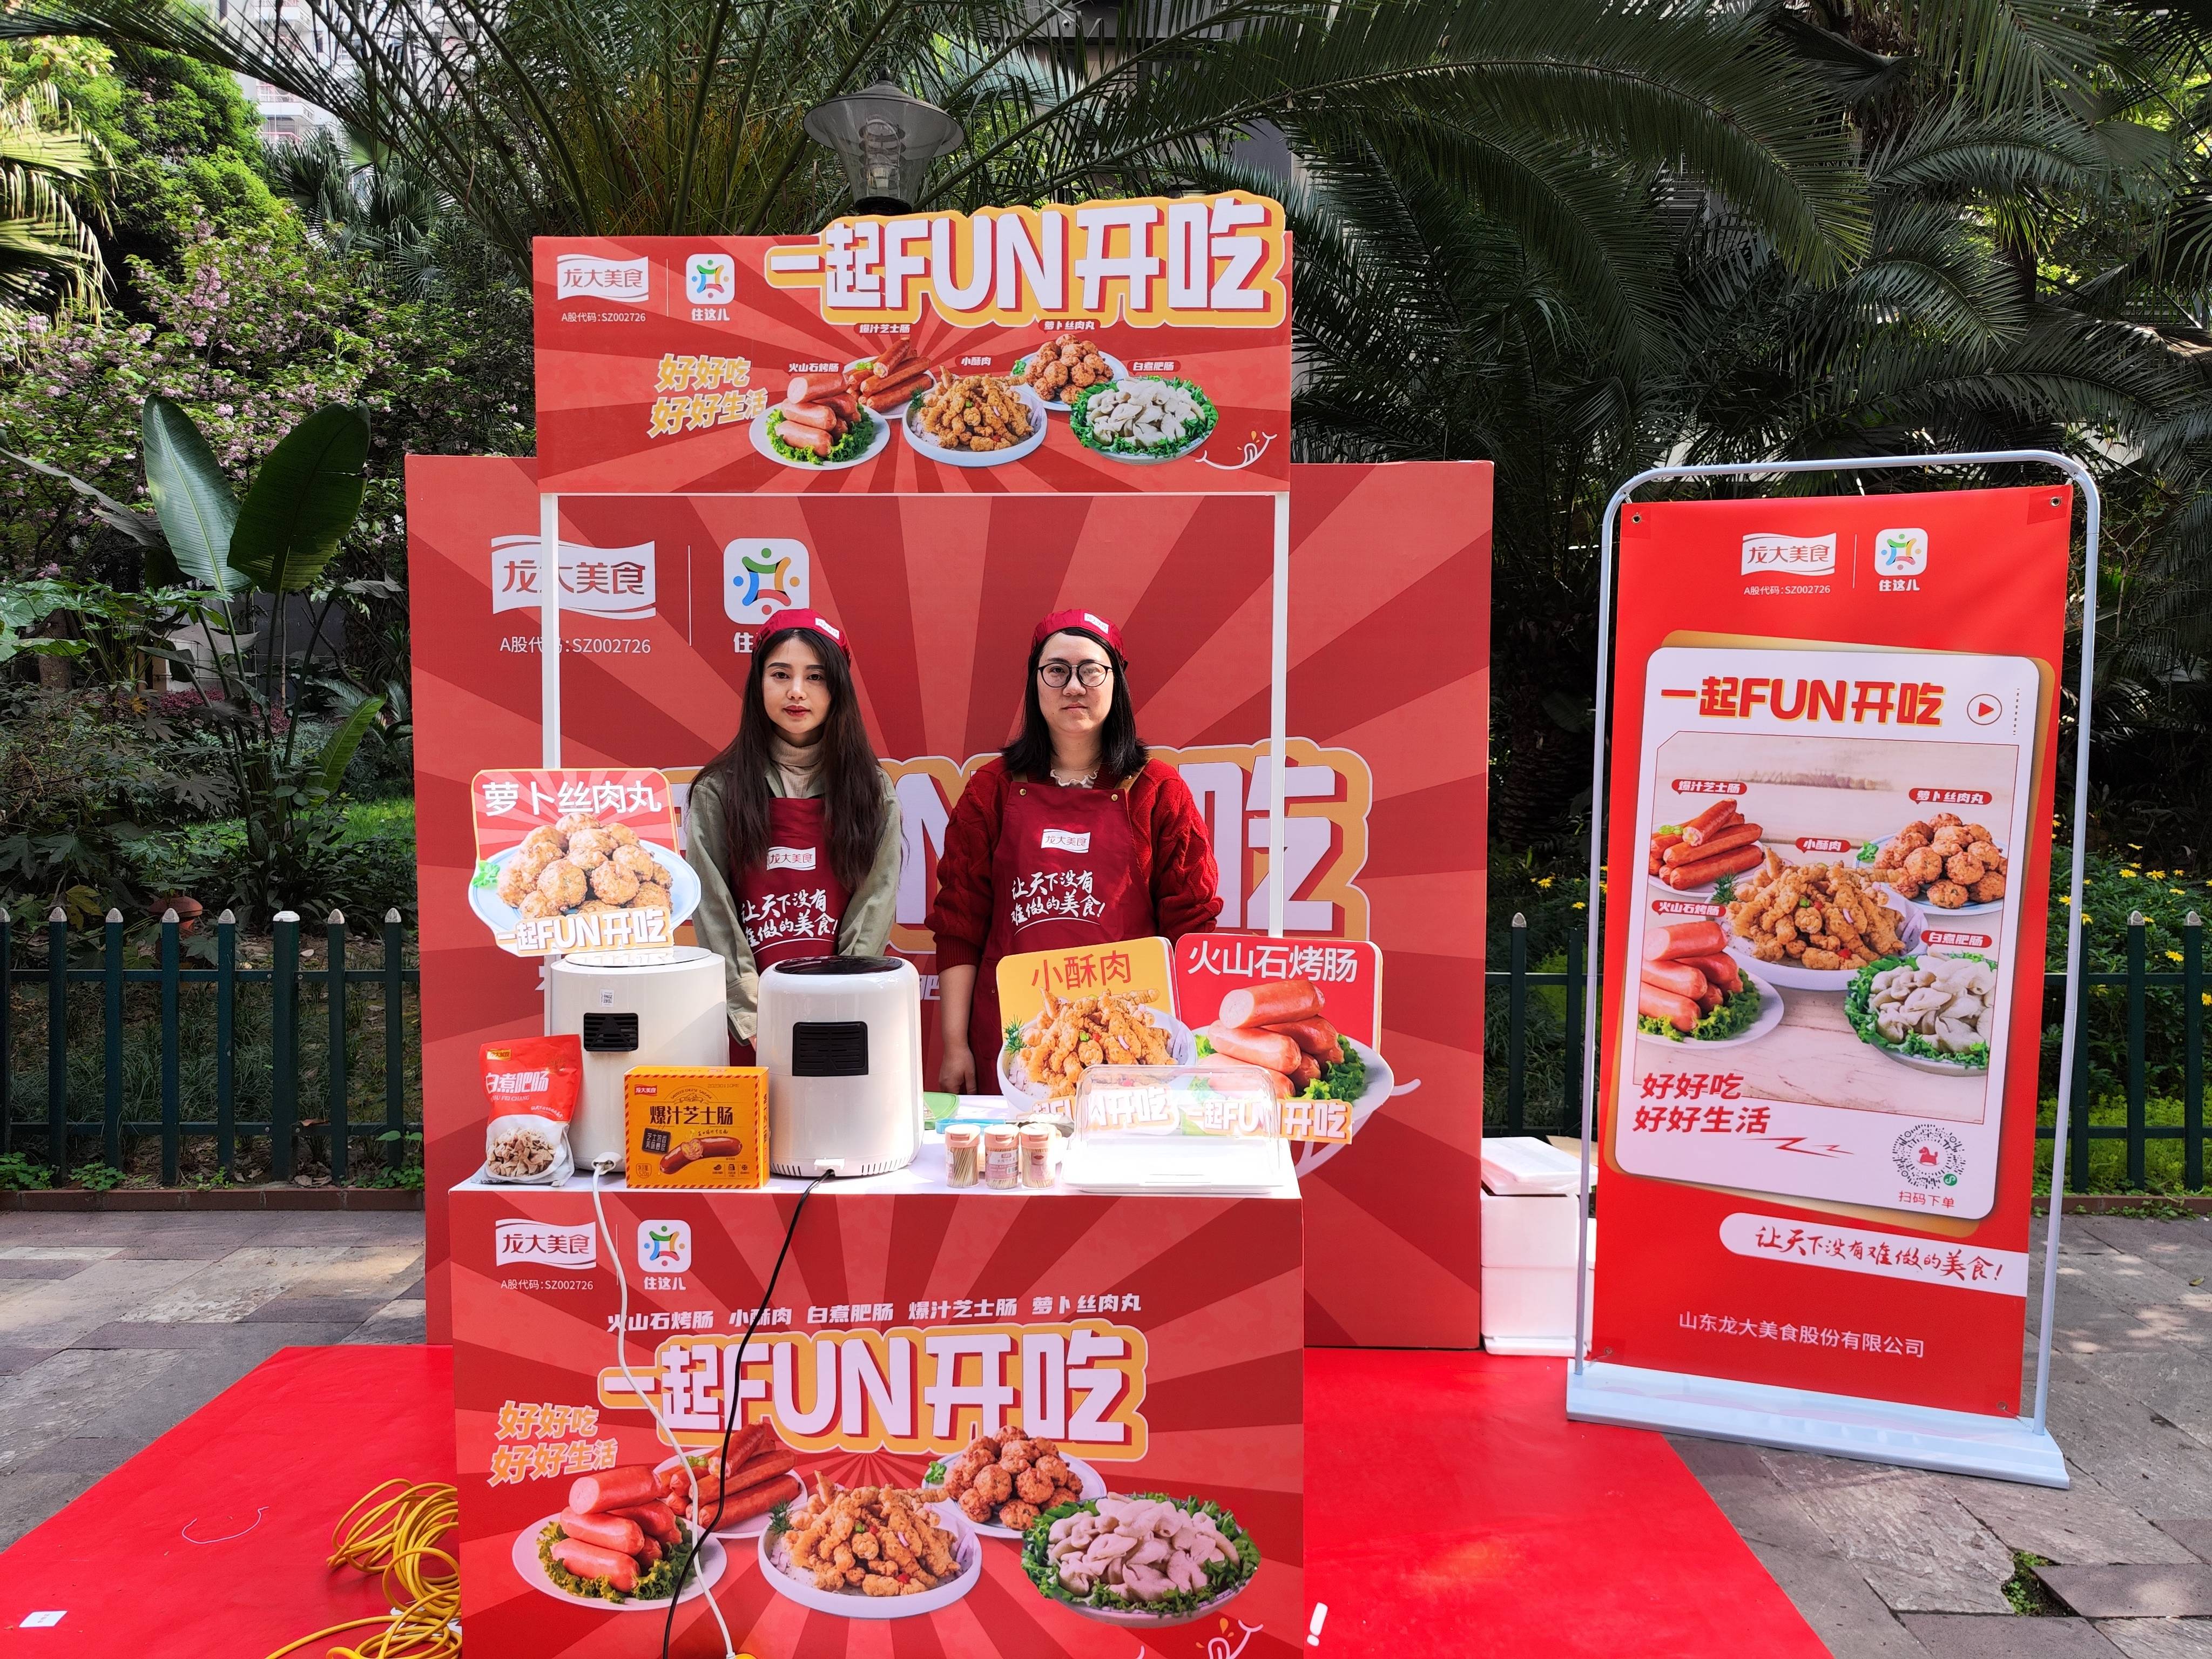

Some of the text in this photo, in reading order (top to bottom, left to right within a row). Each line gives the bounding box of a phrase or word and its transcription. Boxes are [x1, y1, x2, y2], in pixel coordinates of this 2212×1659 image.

[771, 198, 1267, 310] 一起FUN开吃
[563, 268, 643, 289] 龙大美食
[561, 312, 646, 323] A股代码:SZ002726
[691, 308, 730, 322] 住这儿
[859, 323, 911, 334] 爆汁芝士肠
[1044, 320, 1096, 331] 萝卜丝肉丸
[788, 362, 839, 373] 火山石烤肠
[961, 356, 992, 367] 小酥肉
[1132, 361, 1175, 373] 白煮肥肠
[656, 353, 752, 393] 好好吃
[646, 387, 769, 439] 好好生活
[1747, 544, 1830, 564] 龙大美食
[1743, 585, 1831, 595] A股代码:SZ002726
[1879, 579, 1920, 591] 住这儿
[500, 636, 651, 653] A股代:SZ002726
[1661, 676, 1945, 727] 一起FUN开吃
[1677, 780, 1741, 794] 爆汁芝士肠
[482, 780, 663, 817] 萝卜丝肉丸
[1917, 790, 1985, 805] 萝卜丝肉丸
[1046, 835, 1087, 847] 龙大美食
[1803, 839, 1842, 851] 小酥肉
[770, 853, 812, 864] 龙大美食
[1011, 870, 1093, 900] 让天下没有
[741, 888, 827, 922] 让天下没有
[1657, 901, 1721, 916] 火山石烤肠
[496, 908, 667, 951] 一起FUN开吃
[1928, 932, 1984, 947] 白煮肥肠
[1031, 949, 1132, 992] 小酥肉
[1188, 940, 1359, 983] 火山石烤肠
[485, 1070, 550, 1094] 白煮肥肠
[1640, 1071, 1745, 1100] 好好吃
[649, 1105, 733, 1125] 爆汁芝士肠
[1632, 1105, 1771, 1134] 好好生活
[1898, 1190, 1955, 1209] 扫码下单
[502, 1233, 590, 1256] 龙大美食
[501, 1278, 594, 1291] A股代码:SZ002726
[644, 1277, 686, 1291] 住这儿
[606, 1292, 1142, 1332] 火山石烤肠 小酥肉 白煮肥肠 爆汁芝士肠 萝卜丝肉丸
[1678, 1311, 1925, 1359] 山东龙大美食股份有限公司
[604, 1329, 1125, 1442] 一起FUN开吃
[493, 1400, 600, 1441] 好好吃
[487, 1437, 619, 1487] 好好生活
